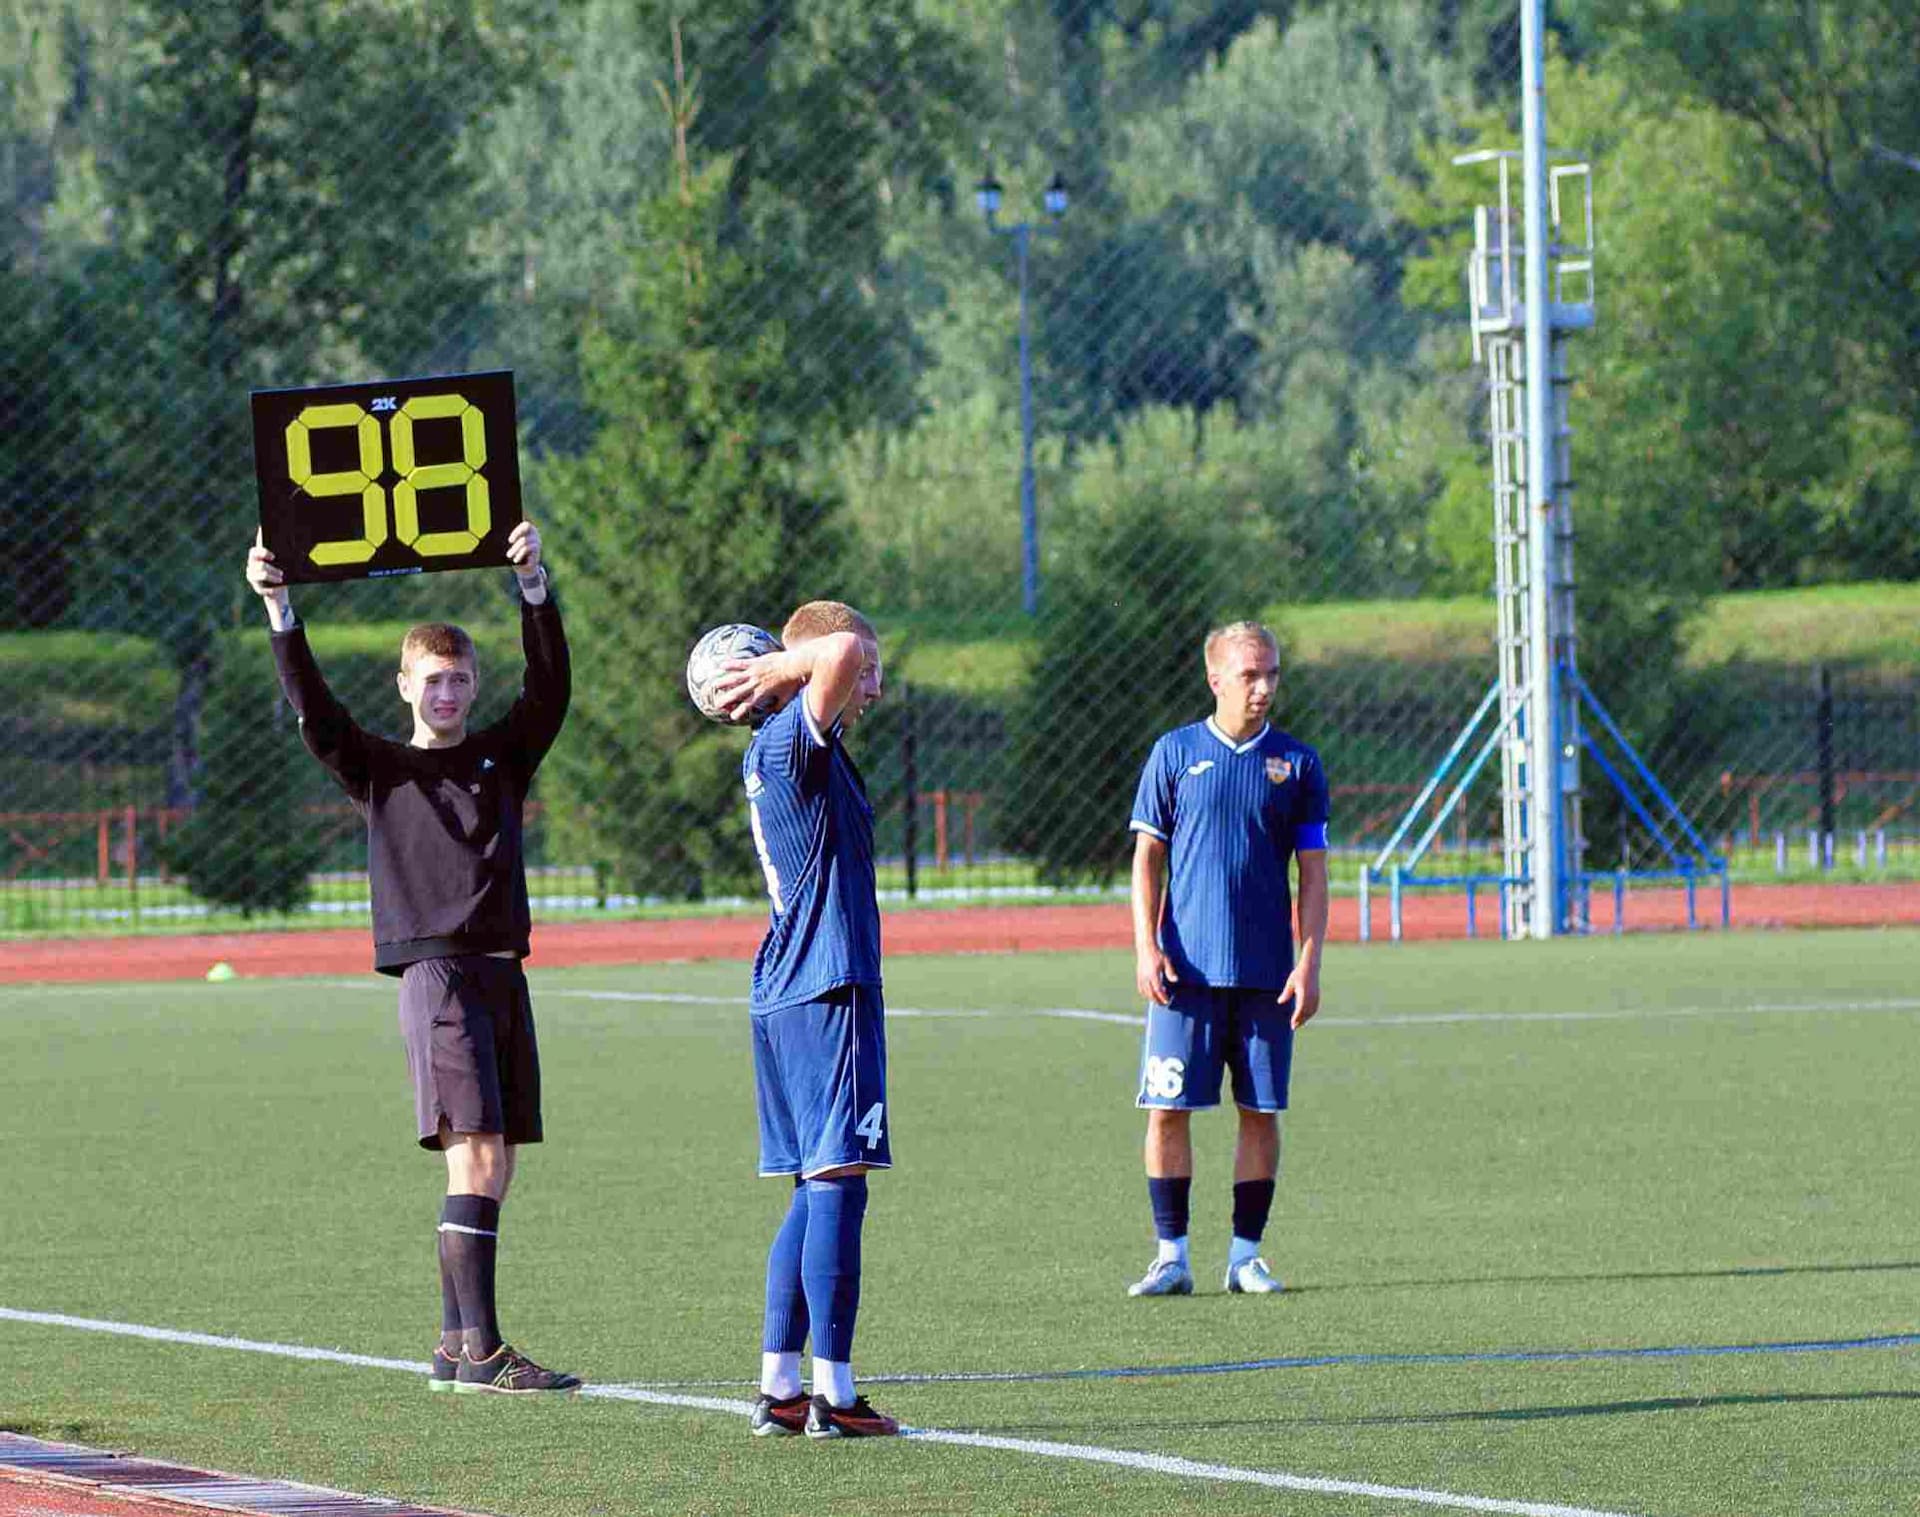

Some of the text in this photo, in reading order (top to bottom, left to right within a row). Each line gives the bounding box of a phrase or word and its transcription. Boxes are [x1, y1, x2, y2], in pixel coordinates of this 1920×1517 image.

[371, 396, 397, 411] 2K
[285, 394, 491, 566] 98
[856, 1102, 883, 1149] 4
